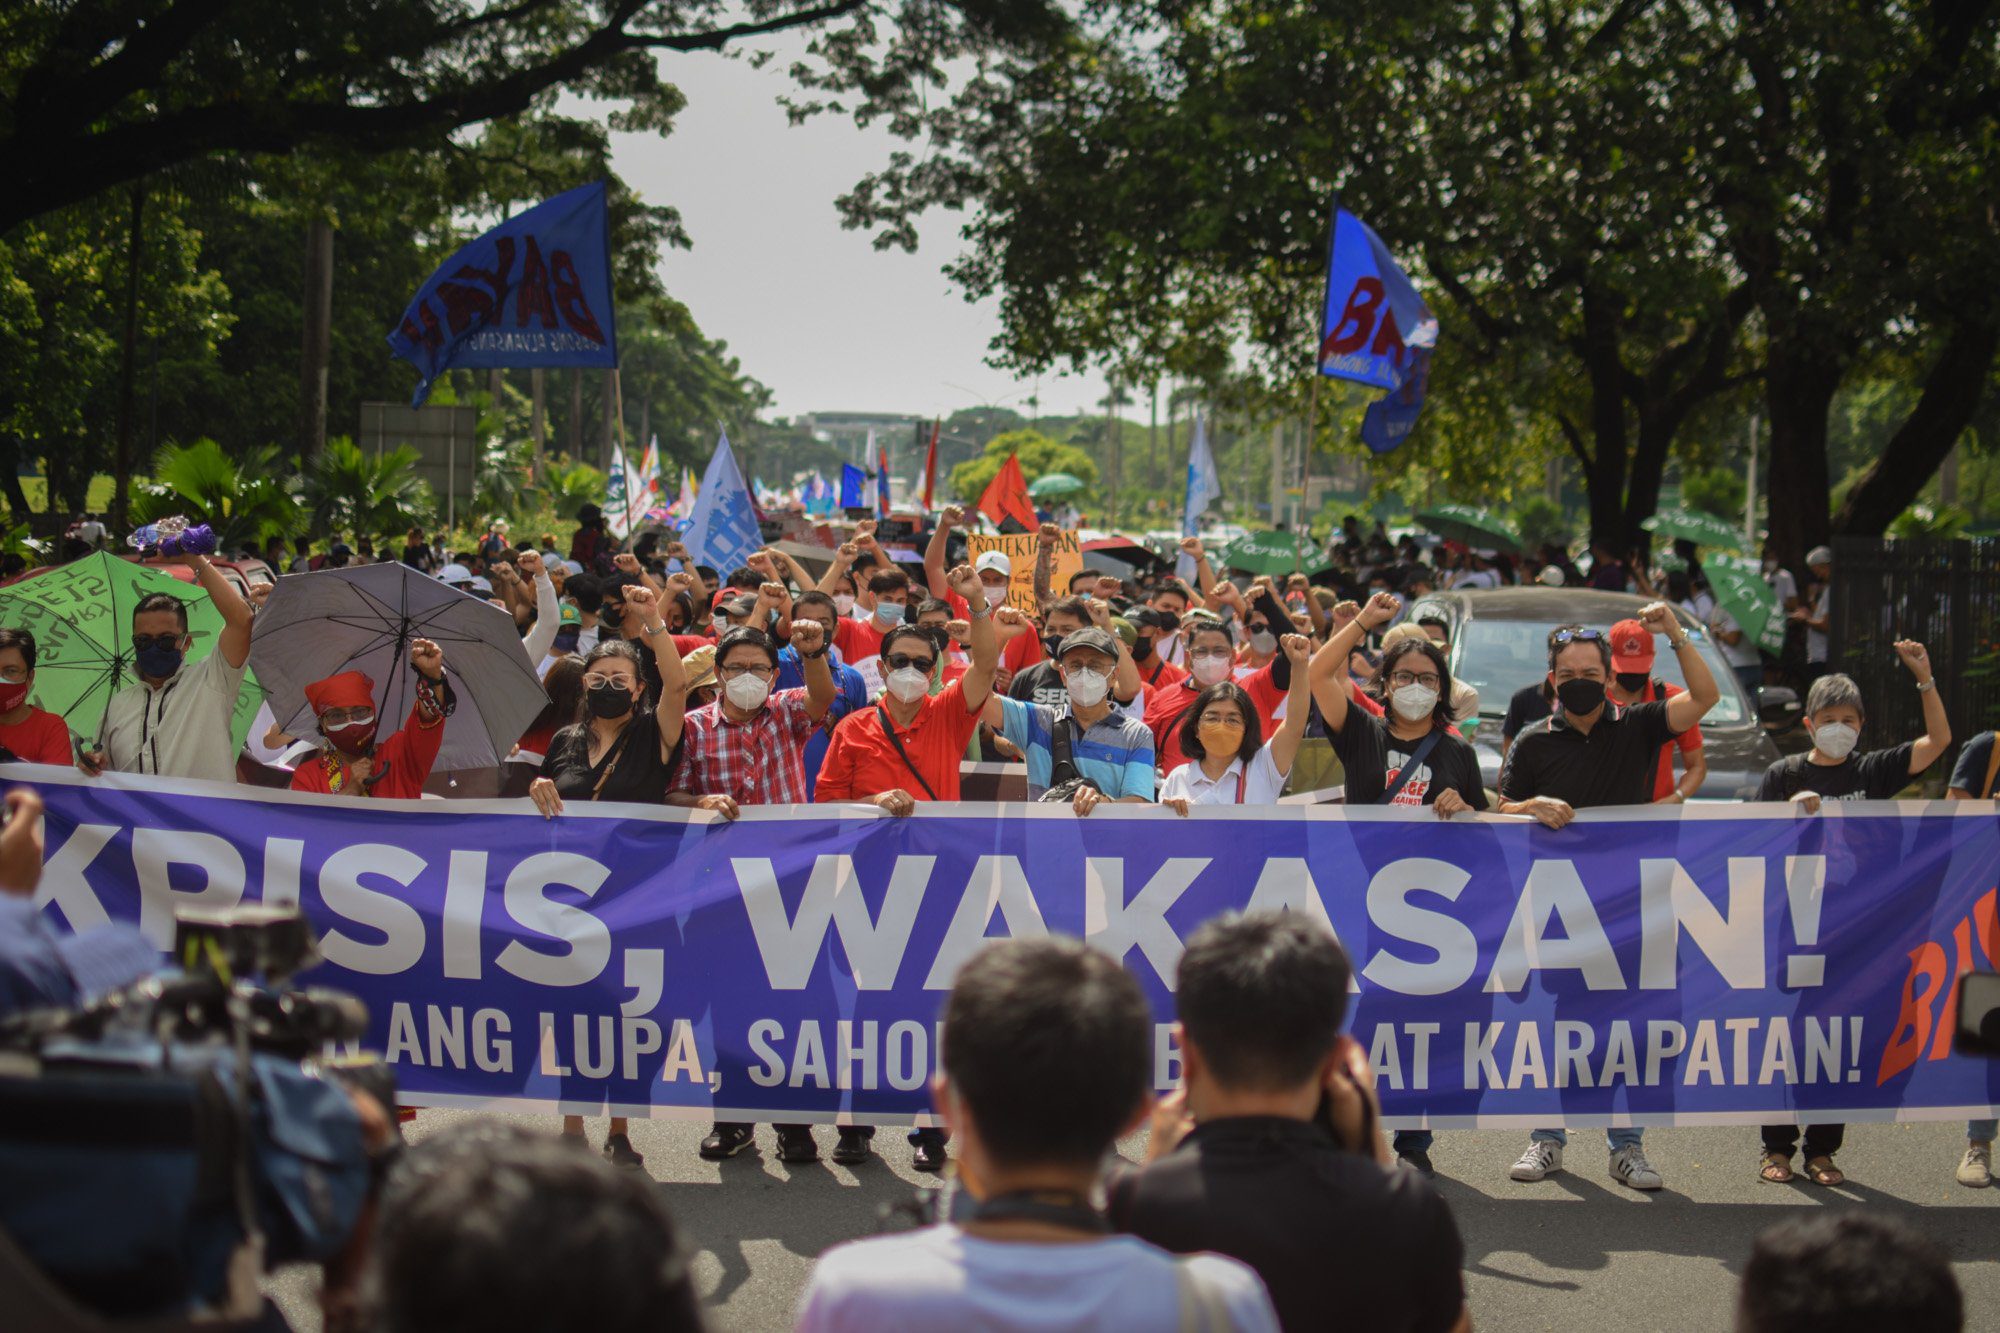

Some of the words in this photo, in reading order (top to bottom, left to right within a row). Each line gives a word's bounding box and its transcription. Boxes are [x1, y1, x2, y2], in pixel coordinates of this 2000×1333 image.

[385, 1001, 514, 1074] ANG
[539, 1012, 722, 1093] LUPA,
[747, 1017, 943, 1090] SAHO
[1372, 1022, 1440, 1090] AT
[1464, 1015, 1864, 1090] KARAPATAN!
